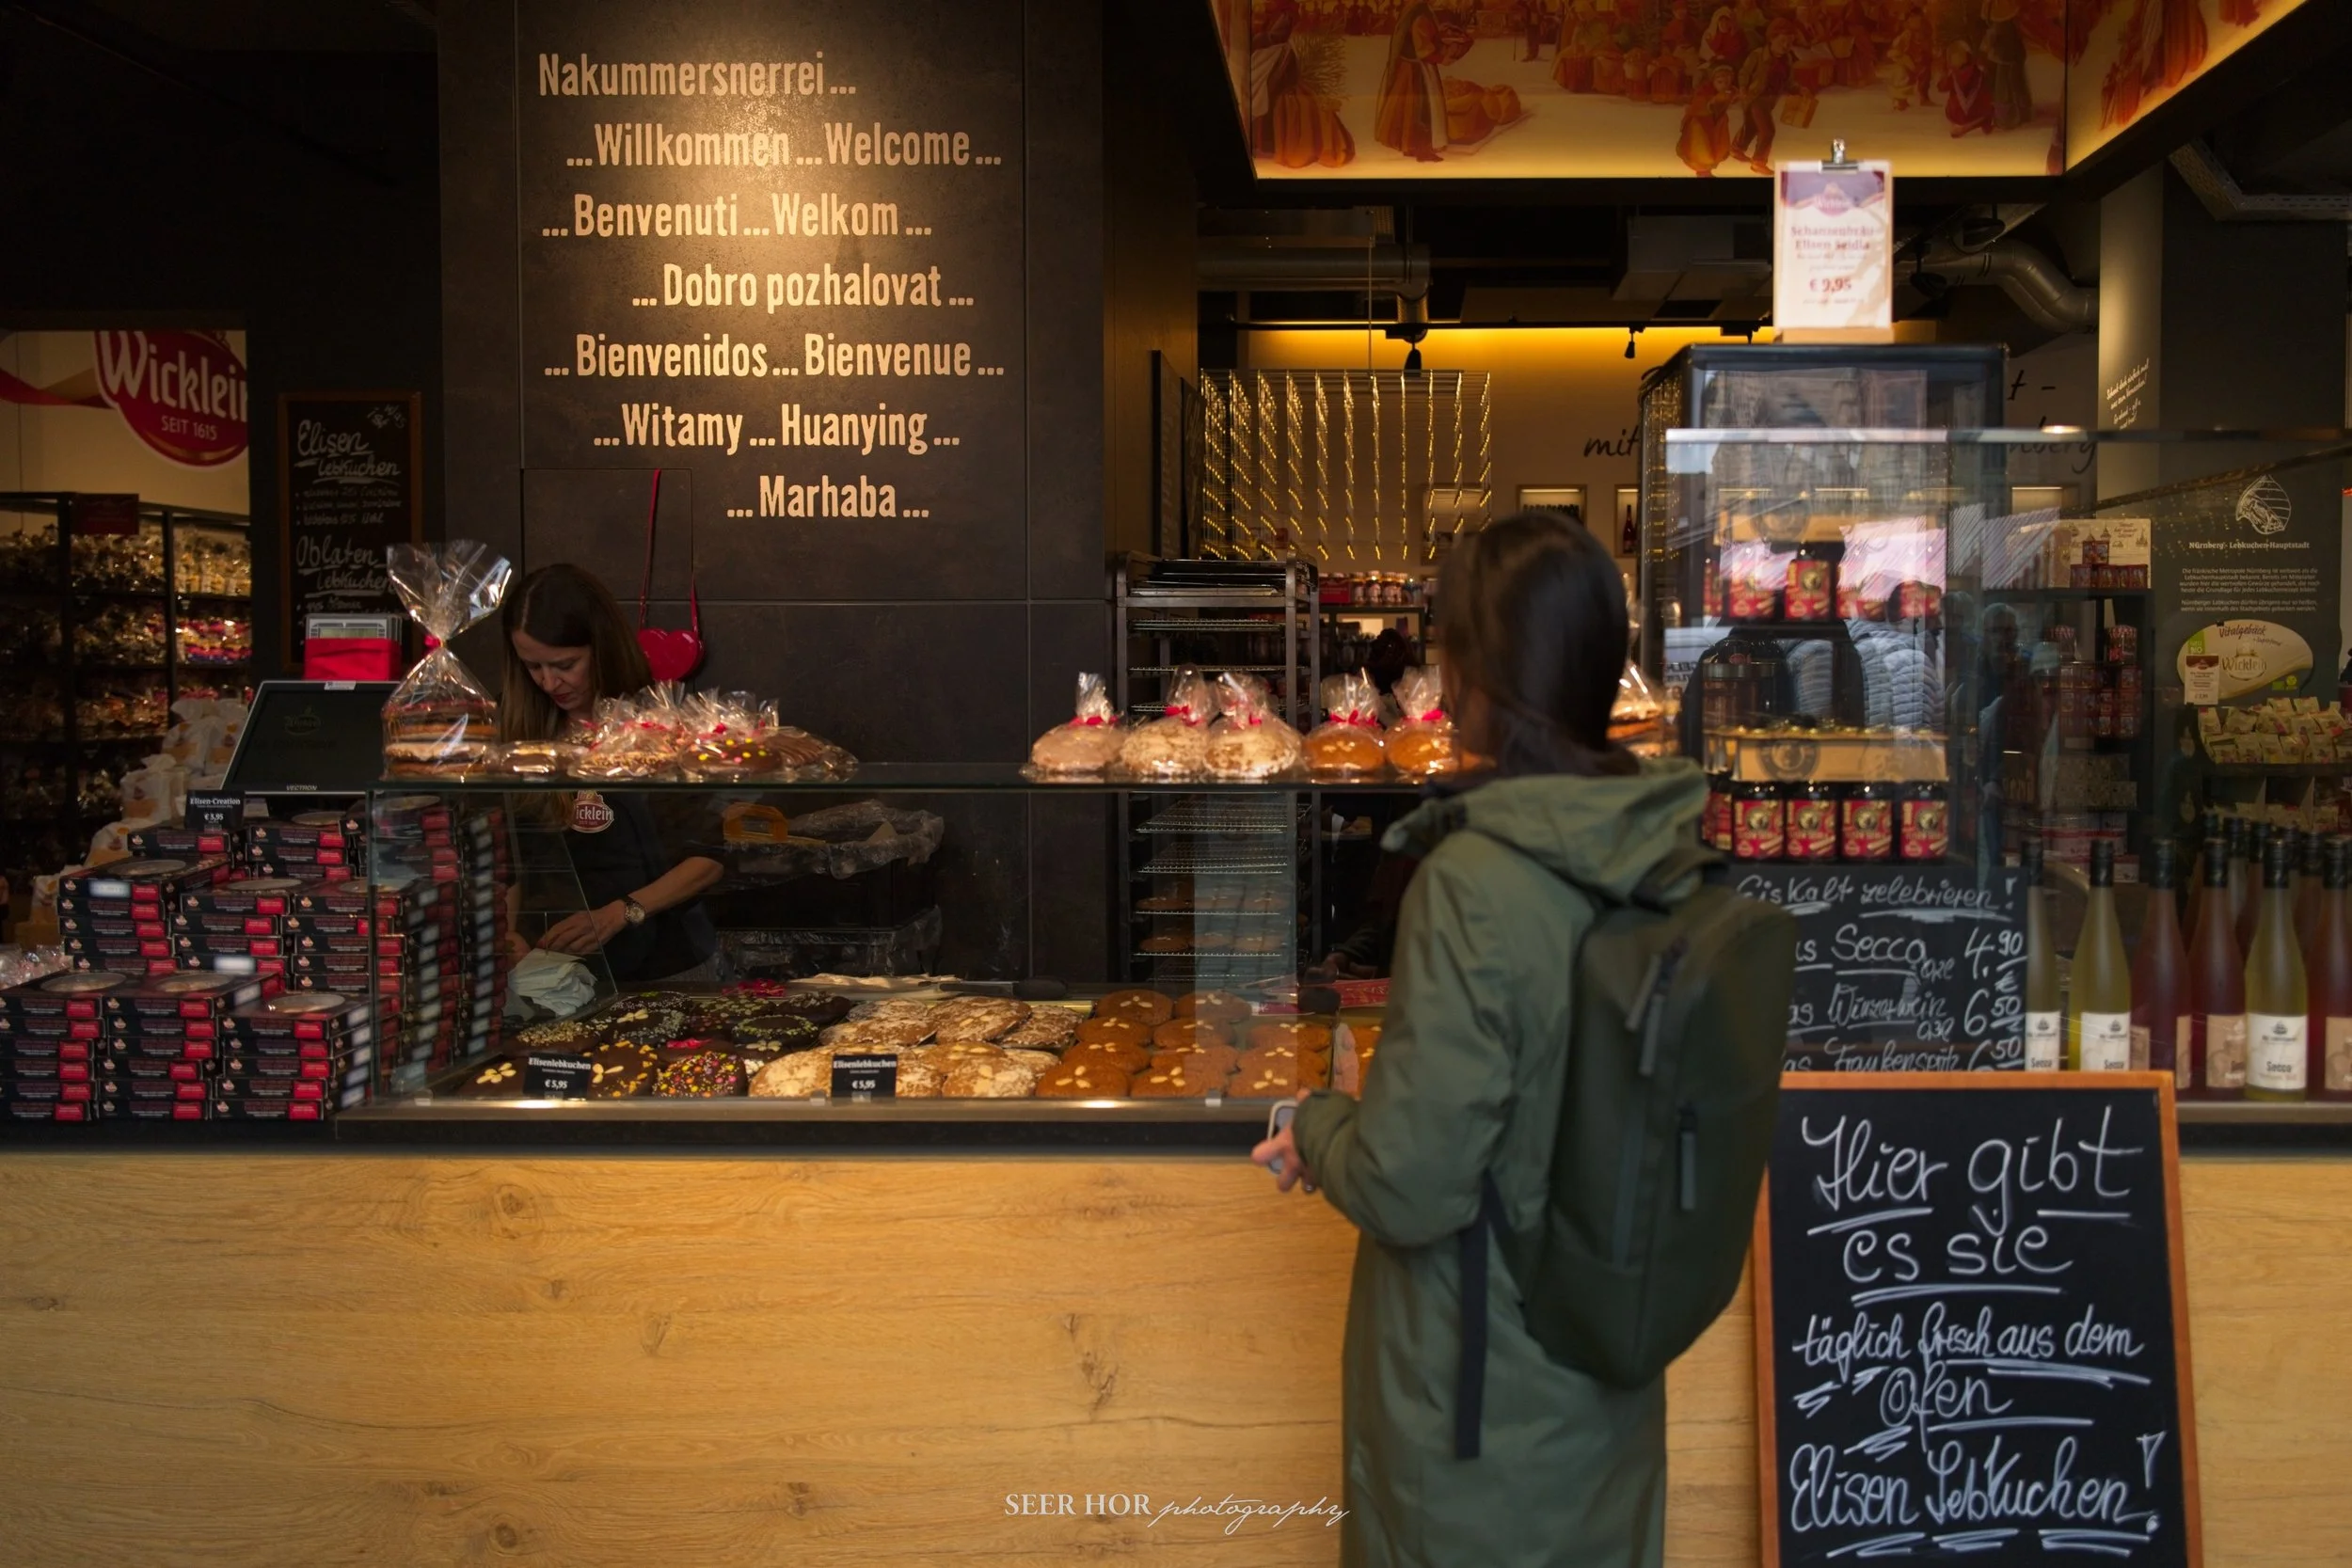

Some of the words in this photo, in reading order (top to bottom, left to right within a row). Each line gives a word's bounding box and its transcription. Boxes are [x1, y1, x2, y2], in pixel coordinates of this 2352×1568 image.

[161, 415, 188, 434] SEIT
[194, 422, 217, 440] 1615
[297, 419, 369, 456] Elisen
[295, 534, 379, 567] Oblaten
[2219, 624, 2266, 640] Vitalgebäck
[189, 797, 241, 806] Elisen-Creation
[576, 805, 612, 820] icklein
[1832, 924, 1926, 965] Secco
[528, 1057, 592, 1070] Elisenlebkuchen
[833, 1059, 898, 1069] Elisenlebkuchen
[1801, 1115, 1948, 1212] Hier
[1967, 1105, 2144, 1238] gibt
[1842, 1228, 1920, 1283] es
[1946, 1226, 2074, 1275] sie
[1791, 1311, 1910, 1384] täglich
[1995, 1322, 2055, 1359] aus
[2063, 1304, 2145, 1358] dem
[1881, 1360, 2014, 1451] Ofen
[1789, 1443, 1920, 1533] Elisen
